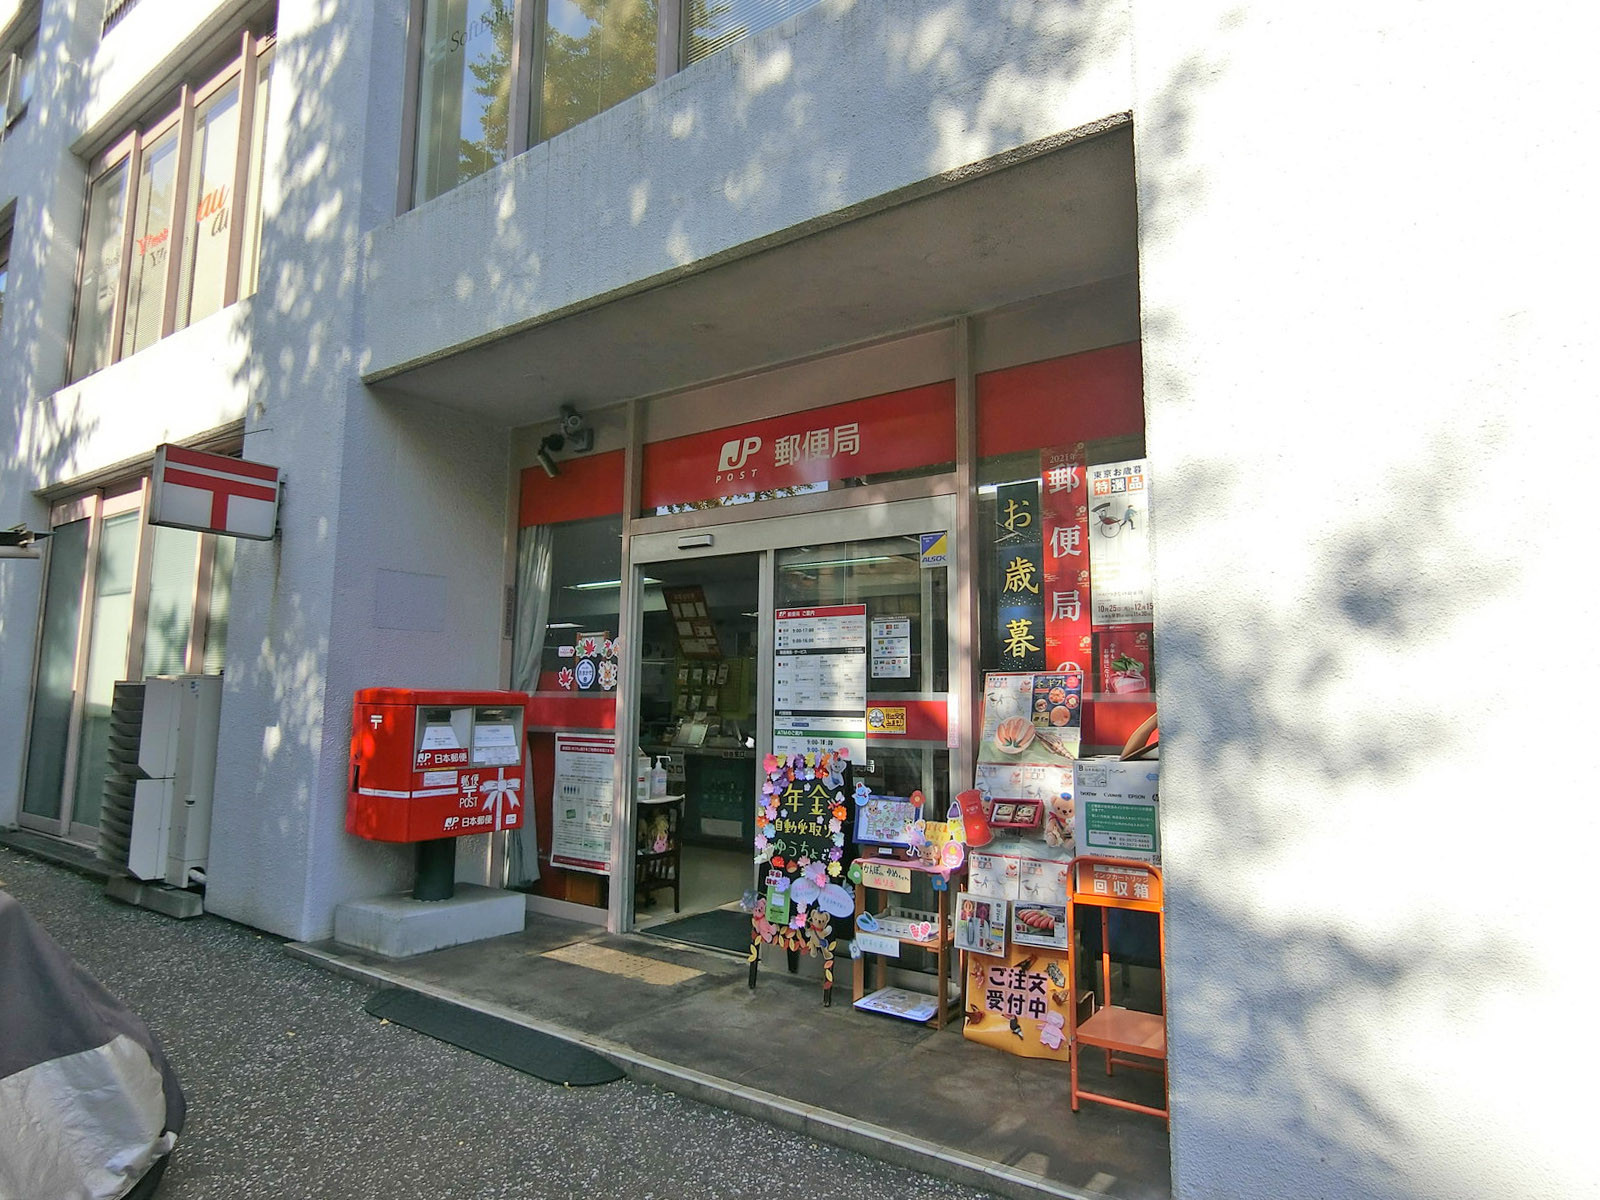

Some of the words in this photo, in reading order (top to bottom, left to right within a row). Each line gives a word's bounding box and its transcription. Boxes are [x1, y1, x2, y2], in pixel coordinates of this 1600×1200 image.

[774, 422, 860, 467] 郵便局
[1049, 453, 1077, 464] 2021年
[715, 468, 758, 484] POST
[1093, 465, 1142, 480] 東京お歳暮
[1094, 475, 1144, 496] 特選品
[922, 555, 947, 563] ALSOK
[1003, 499, 1041, 658] お歳暮
[434, 752, 468, 764] 日本郵便
[459, 796, 478, 809] POST
[783, 783, 831, 816] 年金
[461, 814, 493, 828] 日本郵便
[775, 817, 833, 838] 自動受取り
[1094, 872, 1149, 883] インクカートリッジ
[1093, 879, 1149, 899] 回収箱
[989, 967, 1048, 995] ご注文
[986, 989, 1047, 1019] 受付中
